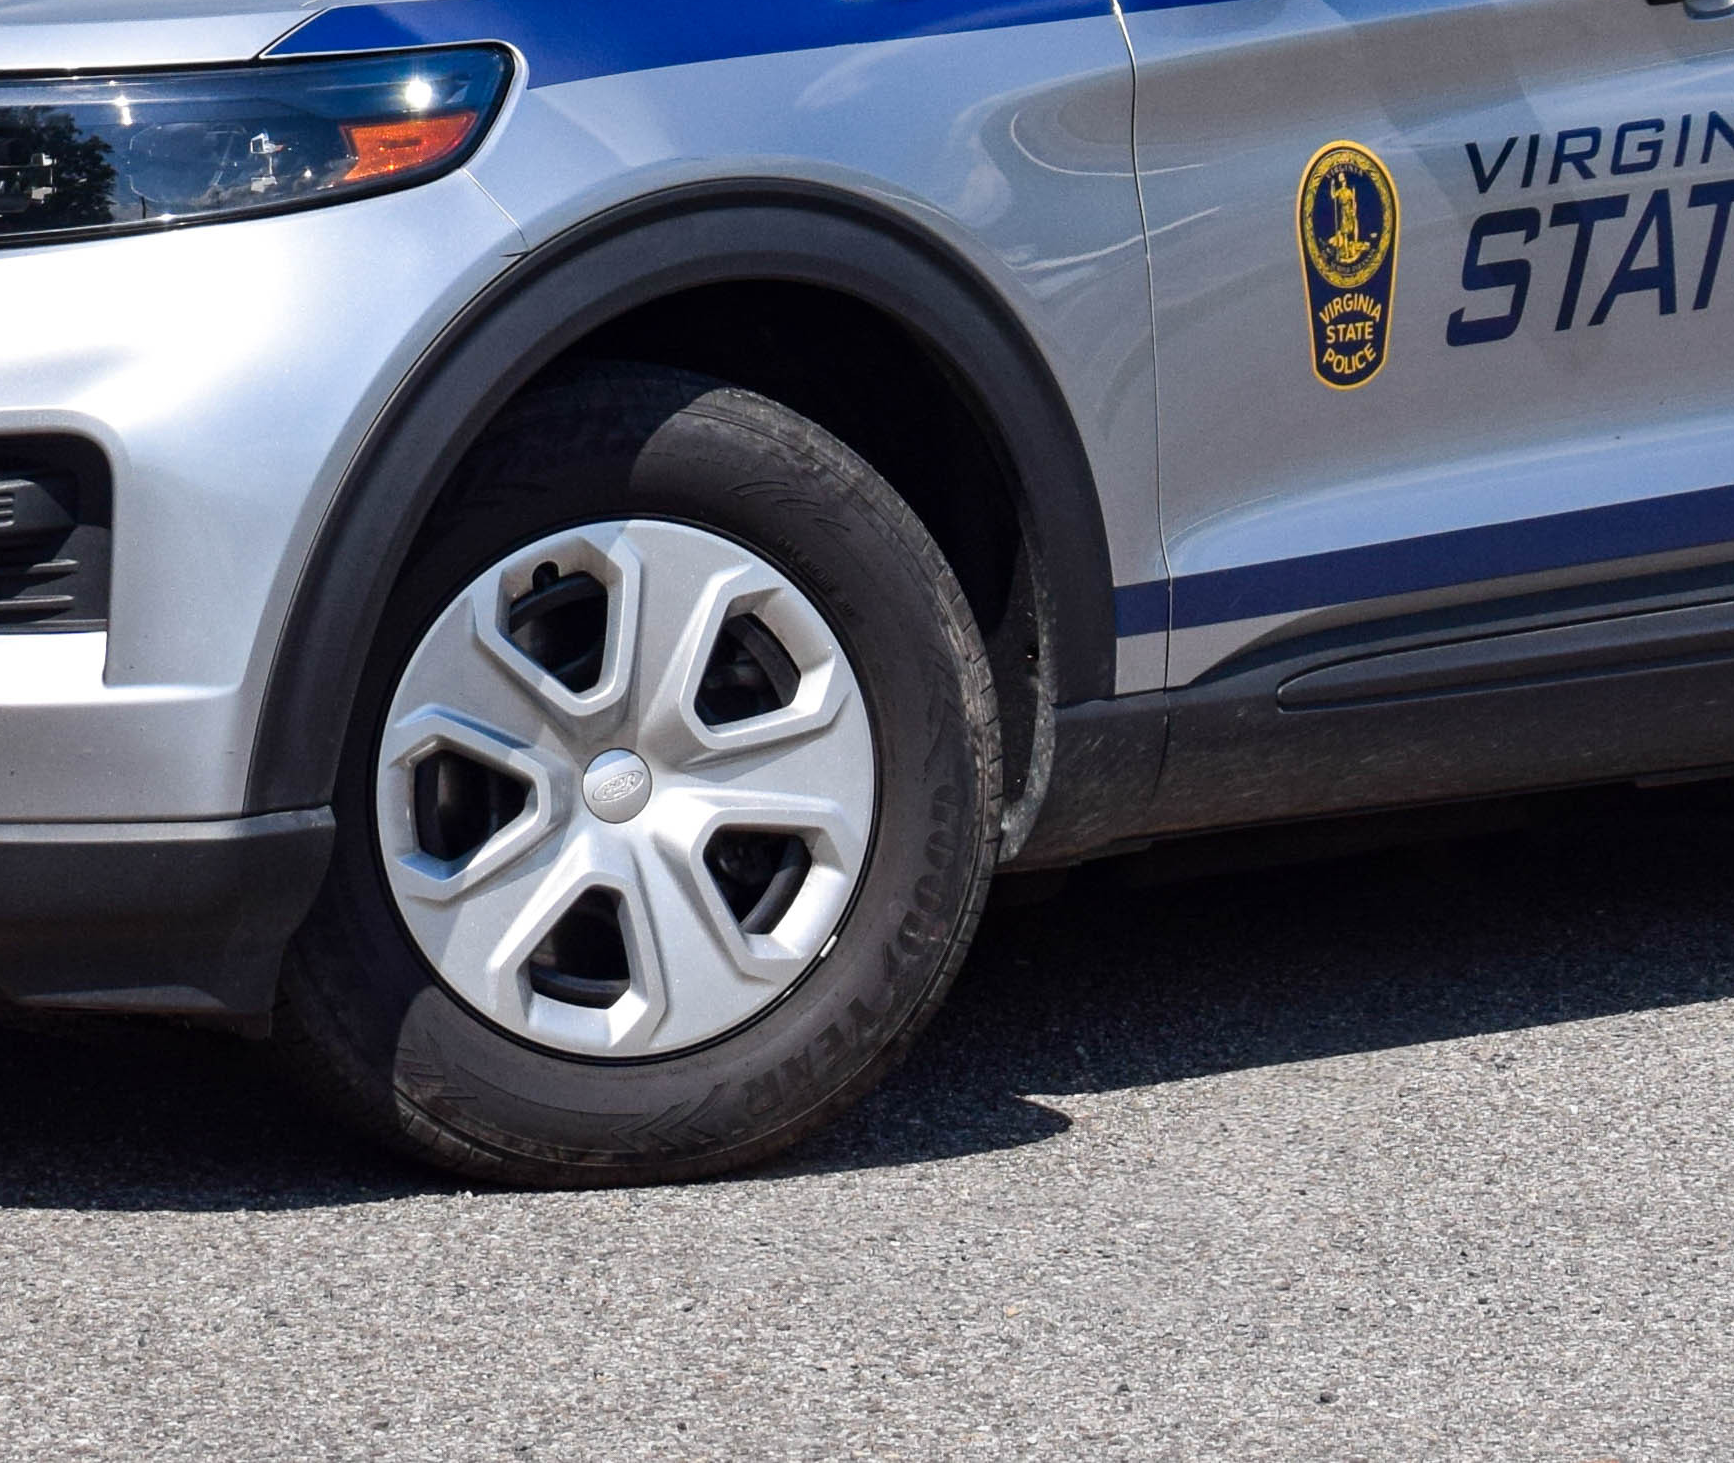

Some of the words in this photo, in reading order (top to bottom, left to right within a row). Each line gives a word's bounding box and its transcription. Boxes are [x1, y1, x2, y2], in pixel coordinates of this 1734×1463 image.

[1319, 293, 1382, 324] VIRGINIA
[1326, 321, 1374, 344] STATE
[1323, 342, 1376, 374] POLICE
